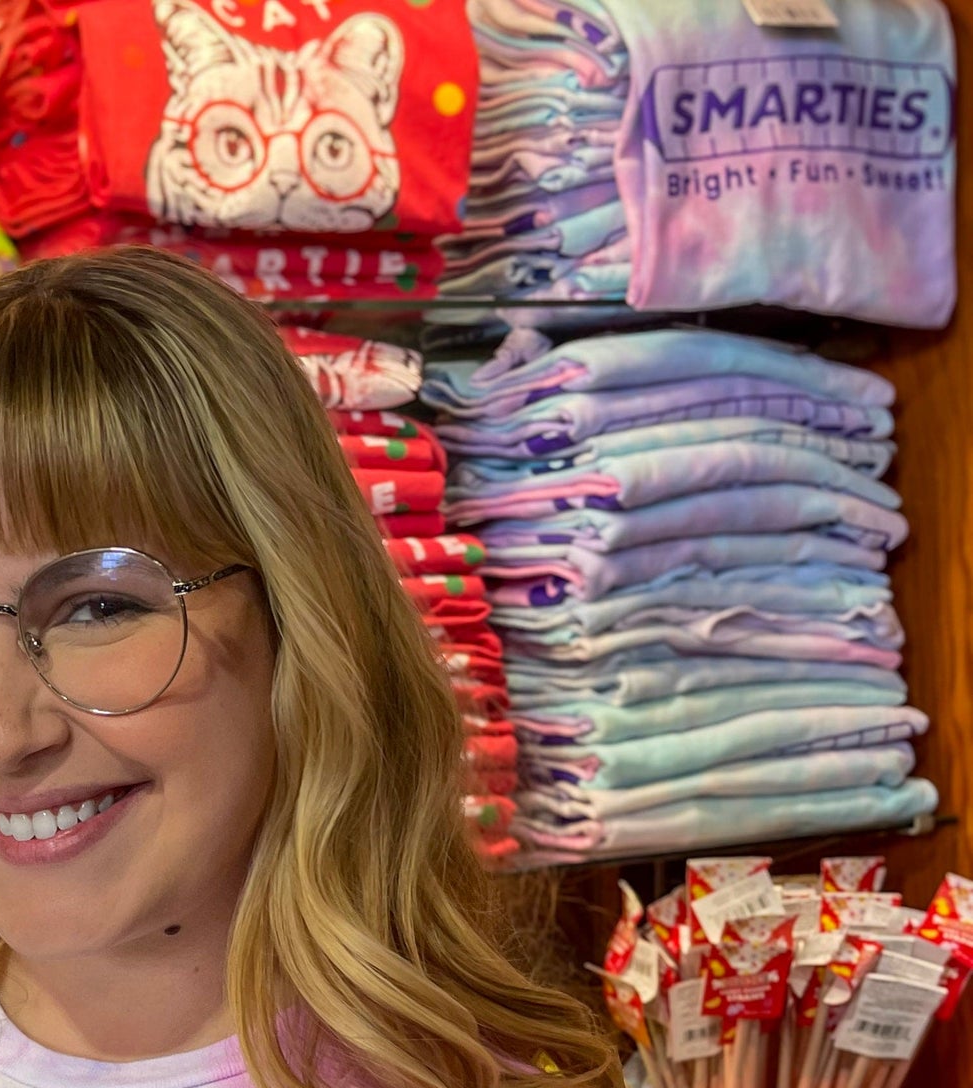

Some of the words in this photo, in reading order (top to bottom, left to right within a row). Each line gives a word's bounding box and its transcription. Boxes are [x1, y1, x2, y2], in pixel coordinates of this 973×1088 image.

[670, 82, 931, 136] SMARTIES
[667, 163, 757, 200] Bright
[789, 159, 839, 183] Fun
